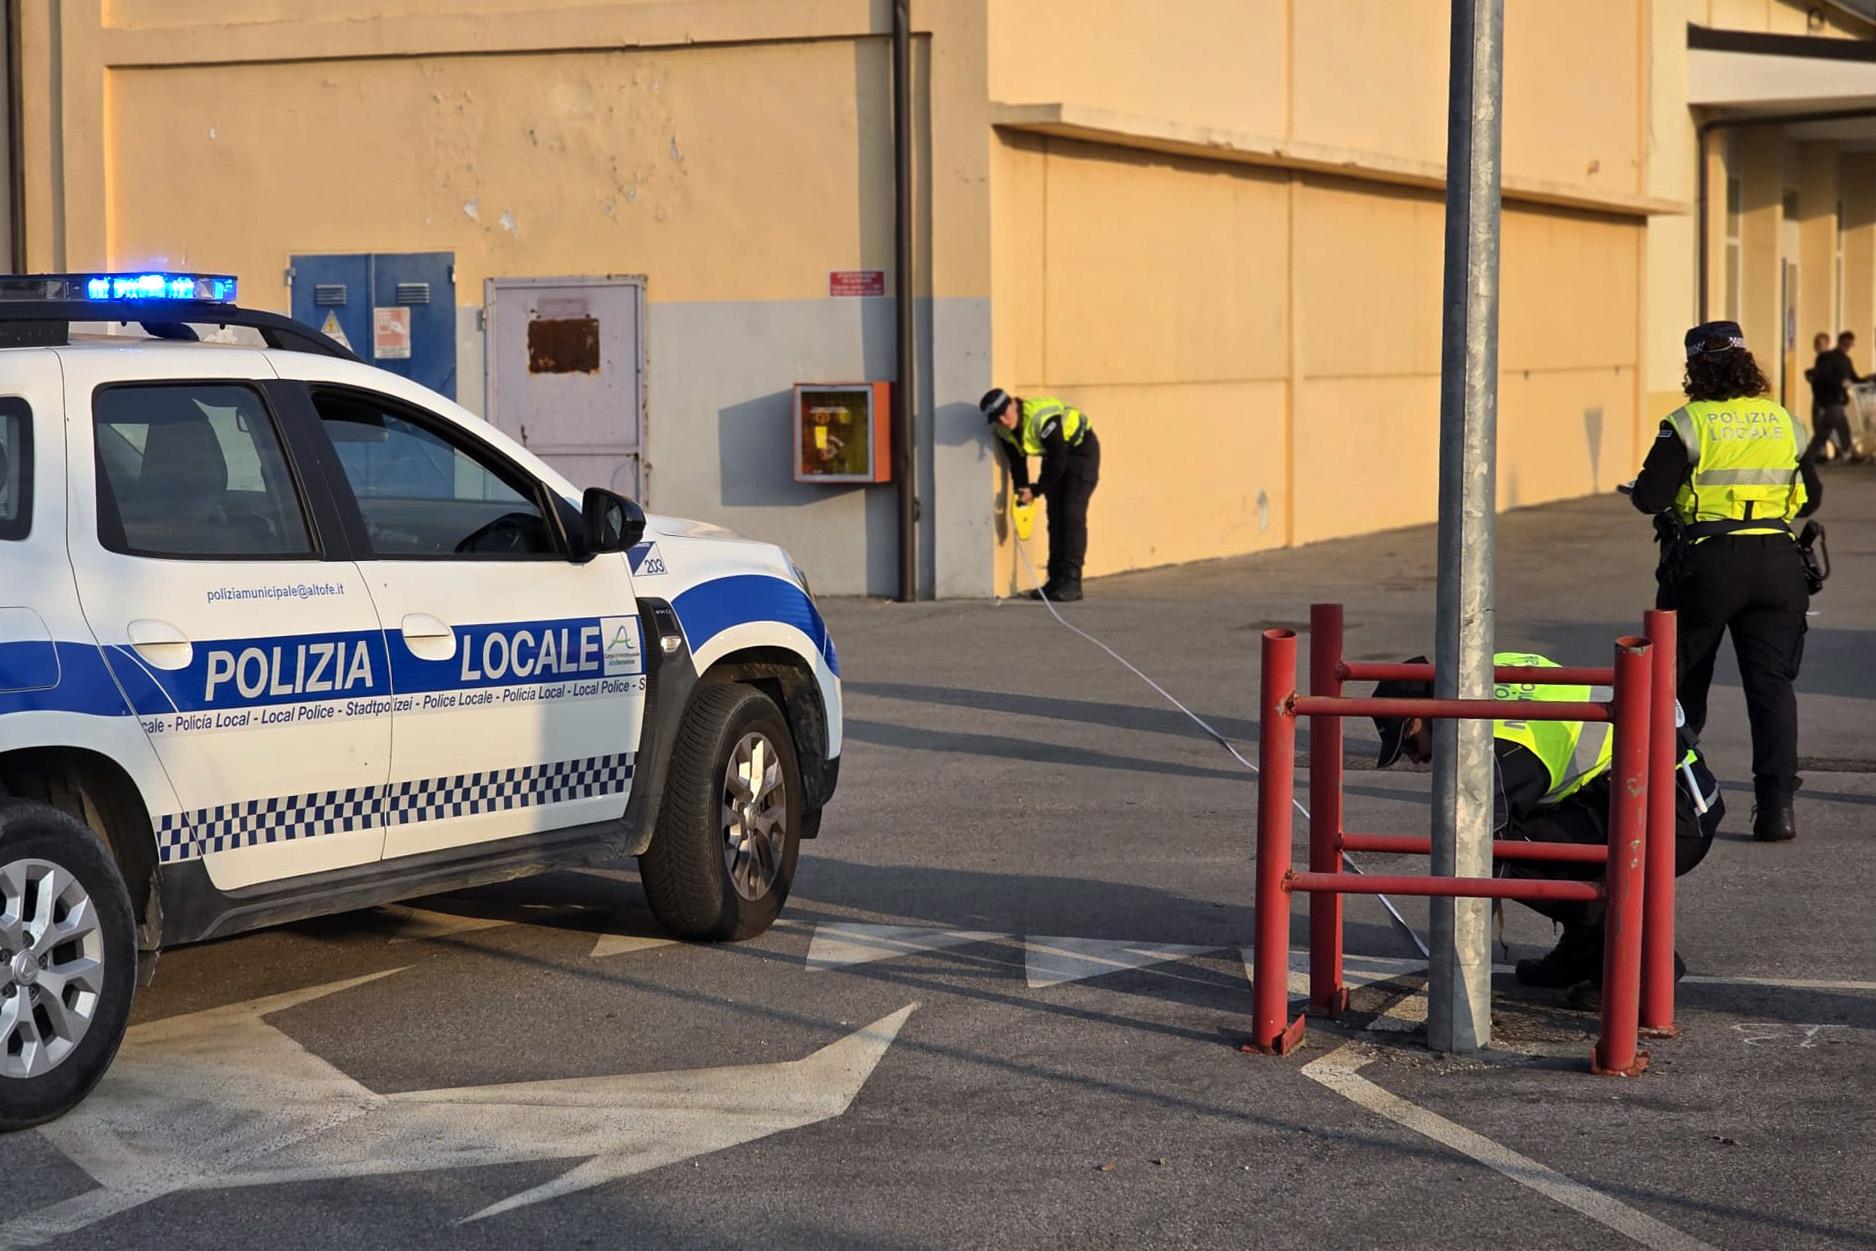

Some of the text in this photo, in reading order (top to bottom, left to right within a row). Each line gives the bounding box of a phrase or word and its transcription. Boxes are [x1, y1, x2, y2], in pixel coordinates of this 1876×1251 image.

[1707, 412, 1779, 424] POLIZIA
[1709, 427, 1783, 441] LOCALE
[644, 559, 664, 574] 203
[207, 583, 344, 603] poliziamunicipale@altofe.it
[204, 626, 600, 702] POLIZIA LOCALE
[215, 710, 251, 728] Local
[261, 707, 295, 724] Local
[298, 704, 335, 721] Police
[345, 696, 413, 717] Stadtpoizei
[423, 693, 456, 709] Police
[459, 690, 493, 706] Locale
[539, 684, 566, 700] Local
[573, 680, 599, 697] Local
[601, 678, 630, 694] Police
